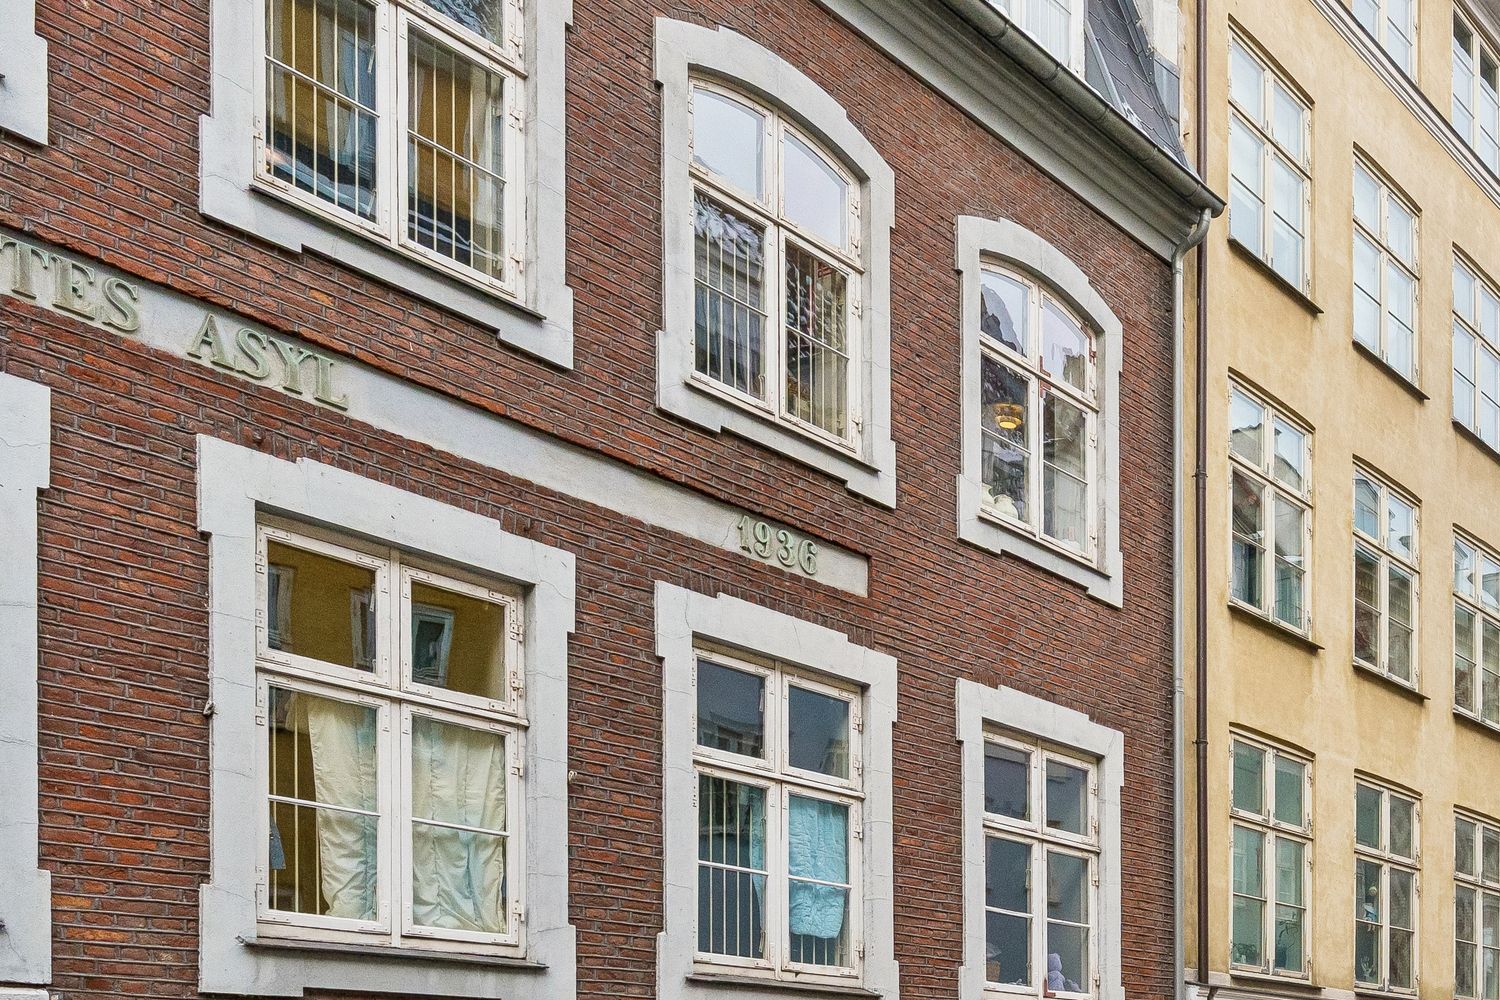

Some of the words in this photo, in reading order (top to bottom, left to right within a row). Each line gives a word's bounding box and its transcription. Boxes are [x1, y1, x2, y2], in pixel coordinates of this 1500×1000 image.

[0, 233, 140, 331] TES
[187, 313, 349, 410] ASYL
[737, 515, 818, 576] 1936
